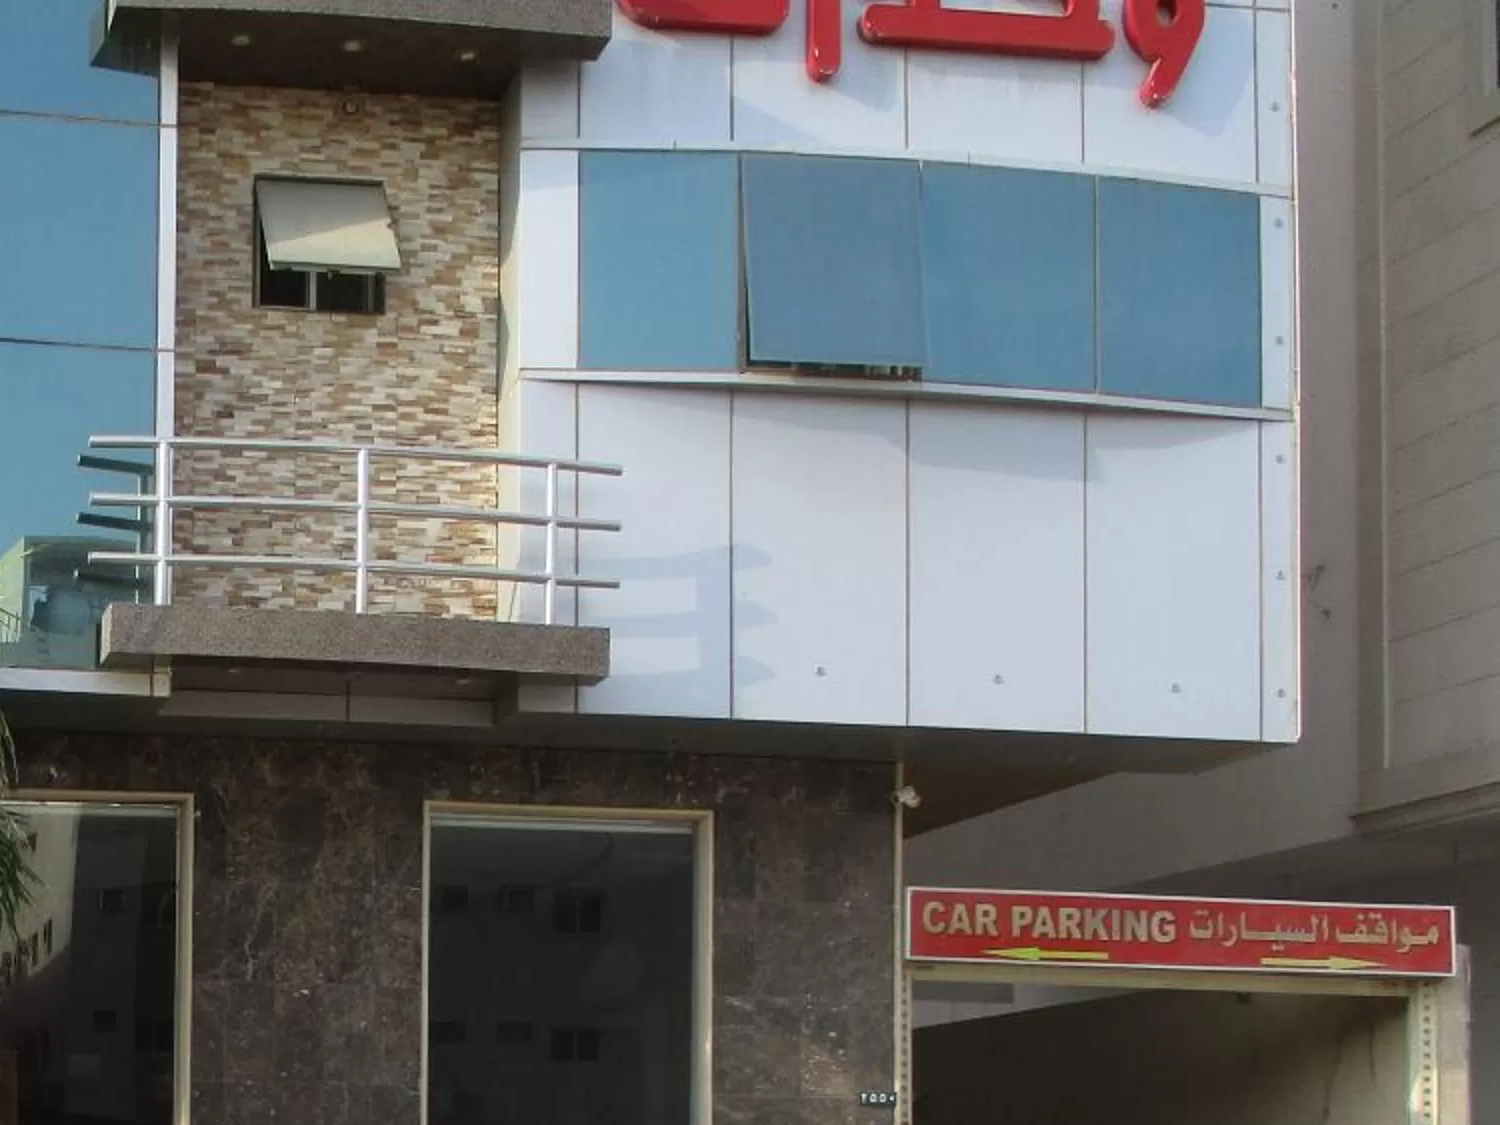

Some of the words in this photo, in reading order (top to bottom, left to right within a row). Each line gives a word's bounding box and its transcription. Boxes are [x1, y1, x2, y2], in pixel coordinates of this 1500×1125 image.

[922, 901, 999, 937] CAR
[1010, 905, 1177, 944] PARKING
[1188, 908, 1329, 952] السيارات
[1335, 911, 1441, 953] مواقف
